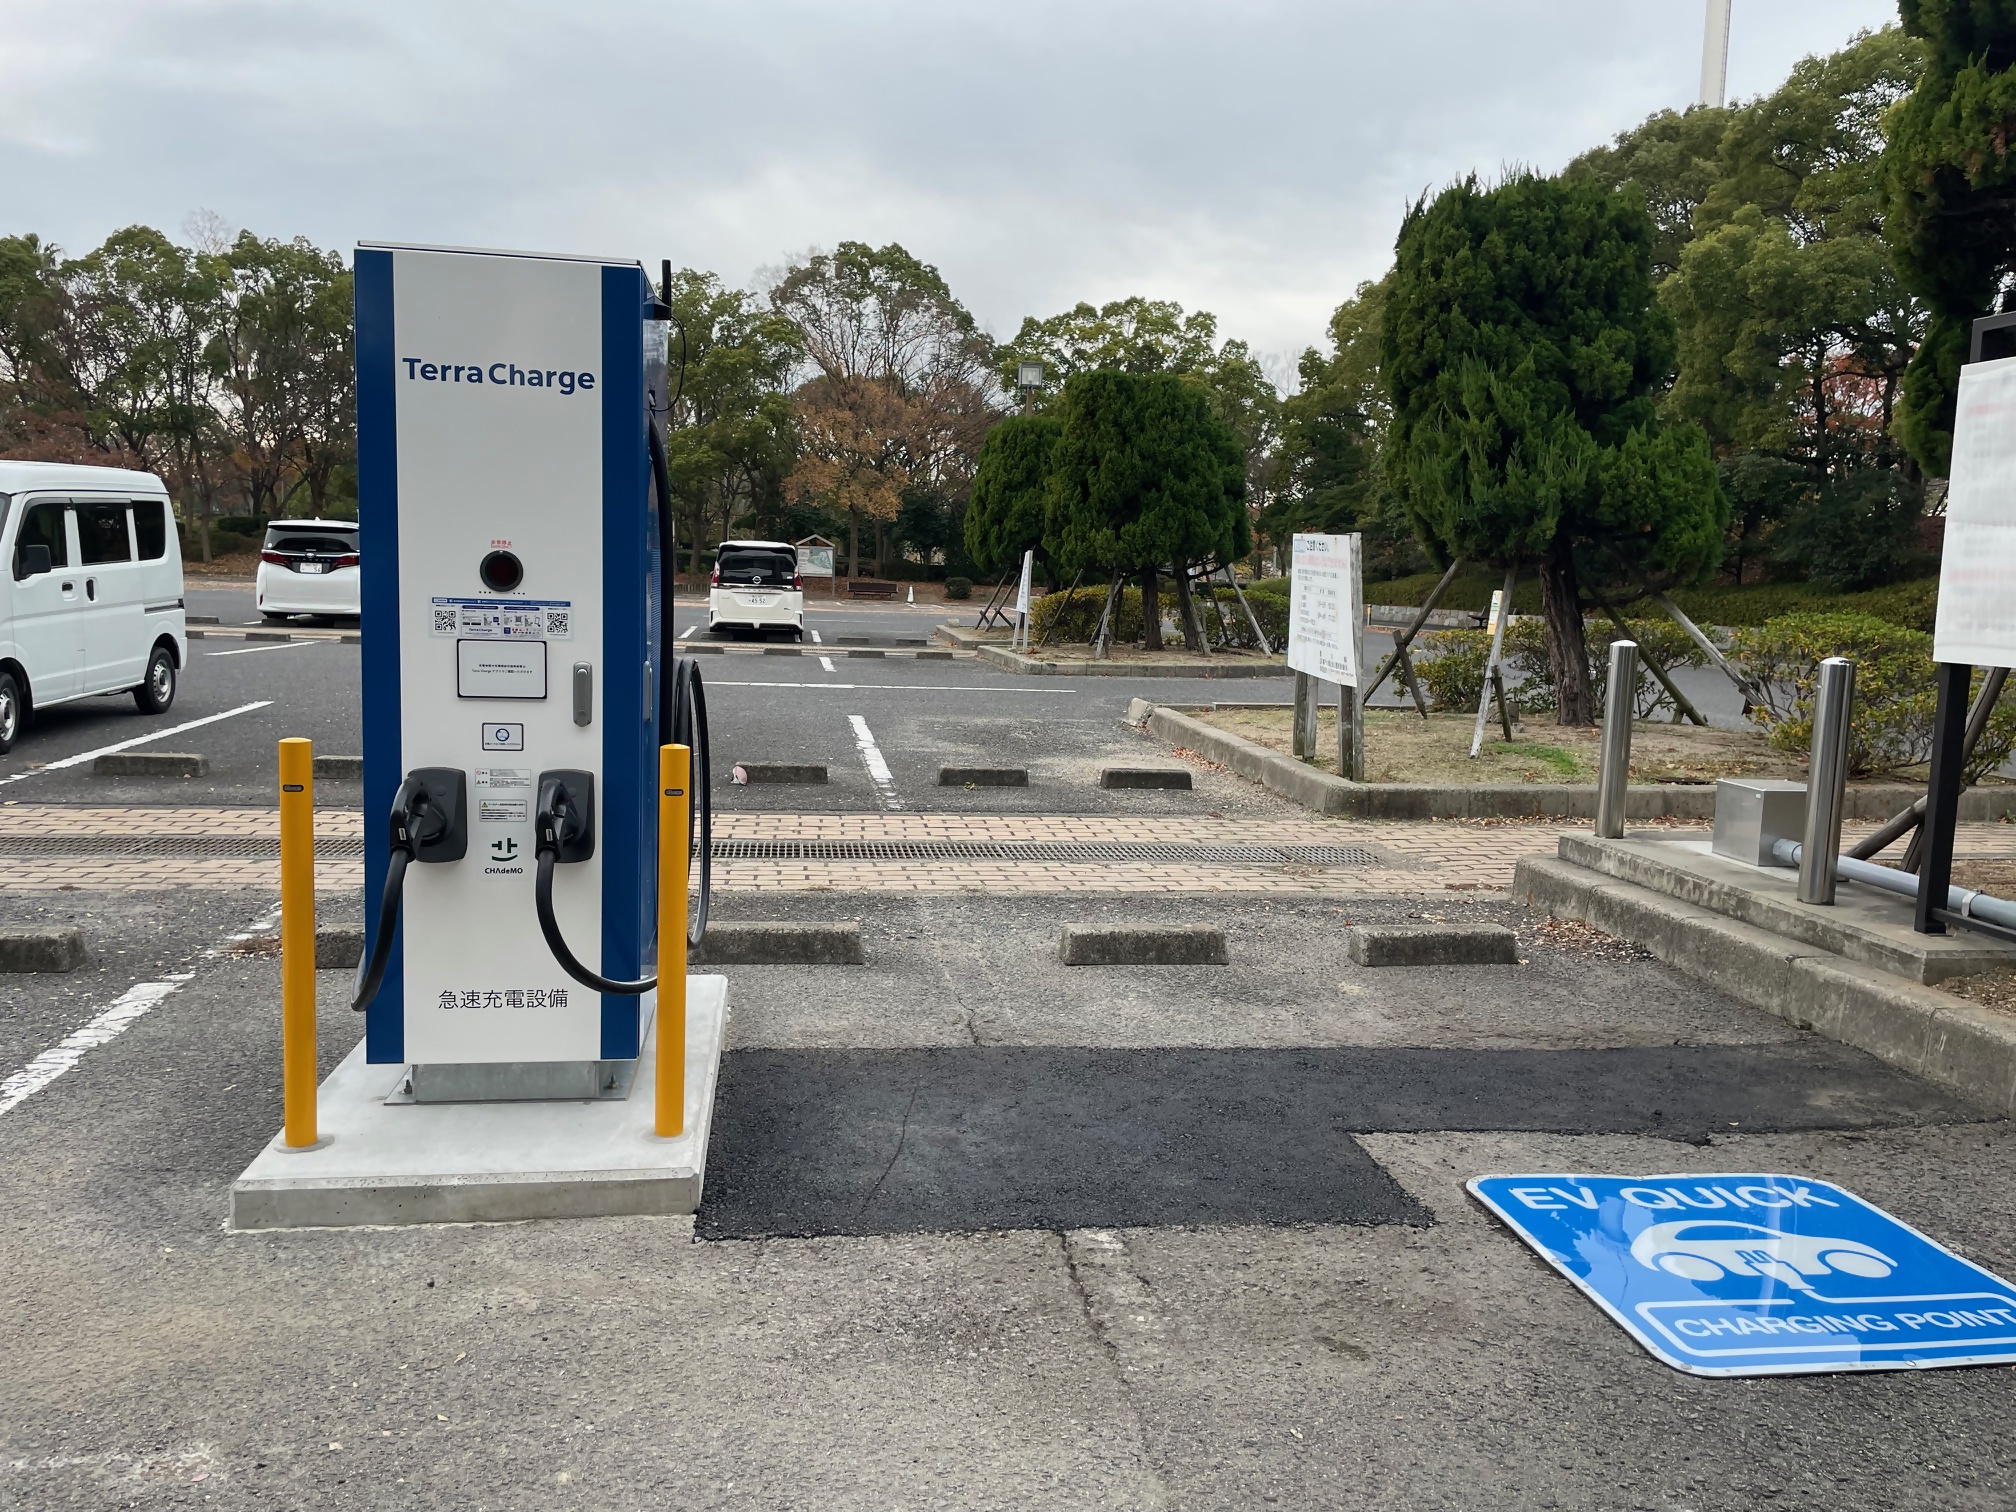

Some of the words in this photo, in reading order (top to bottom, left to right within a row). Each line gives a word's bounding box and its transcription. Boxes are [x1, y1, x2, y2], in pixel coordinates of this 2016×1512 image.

[402, 357, 483, 383] Terra
[488, 362, 595, 395] Charge
[438, 988, 569, 1010] 急速充電設備
[1509, 1187, 1599, 1210] EV
[1619, 1186, 1841, 1210] QUICK
[1674, 1314, 1900, 1338] CHARGING
[1894, 1308, 2016, 1330] POINT
